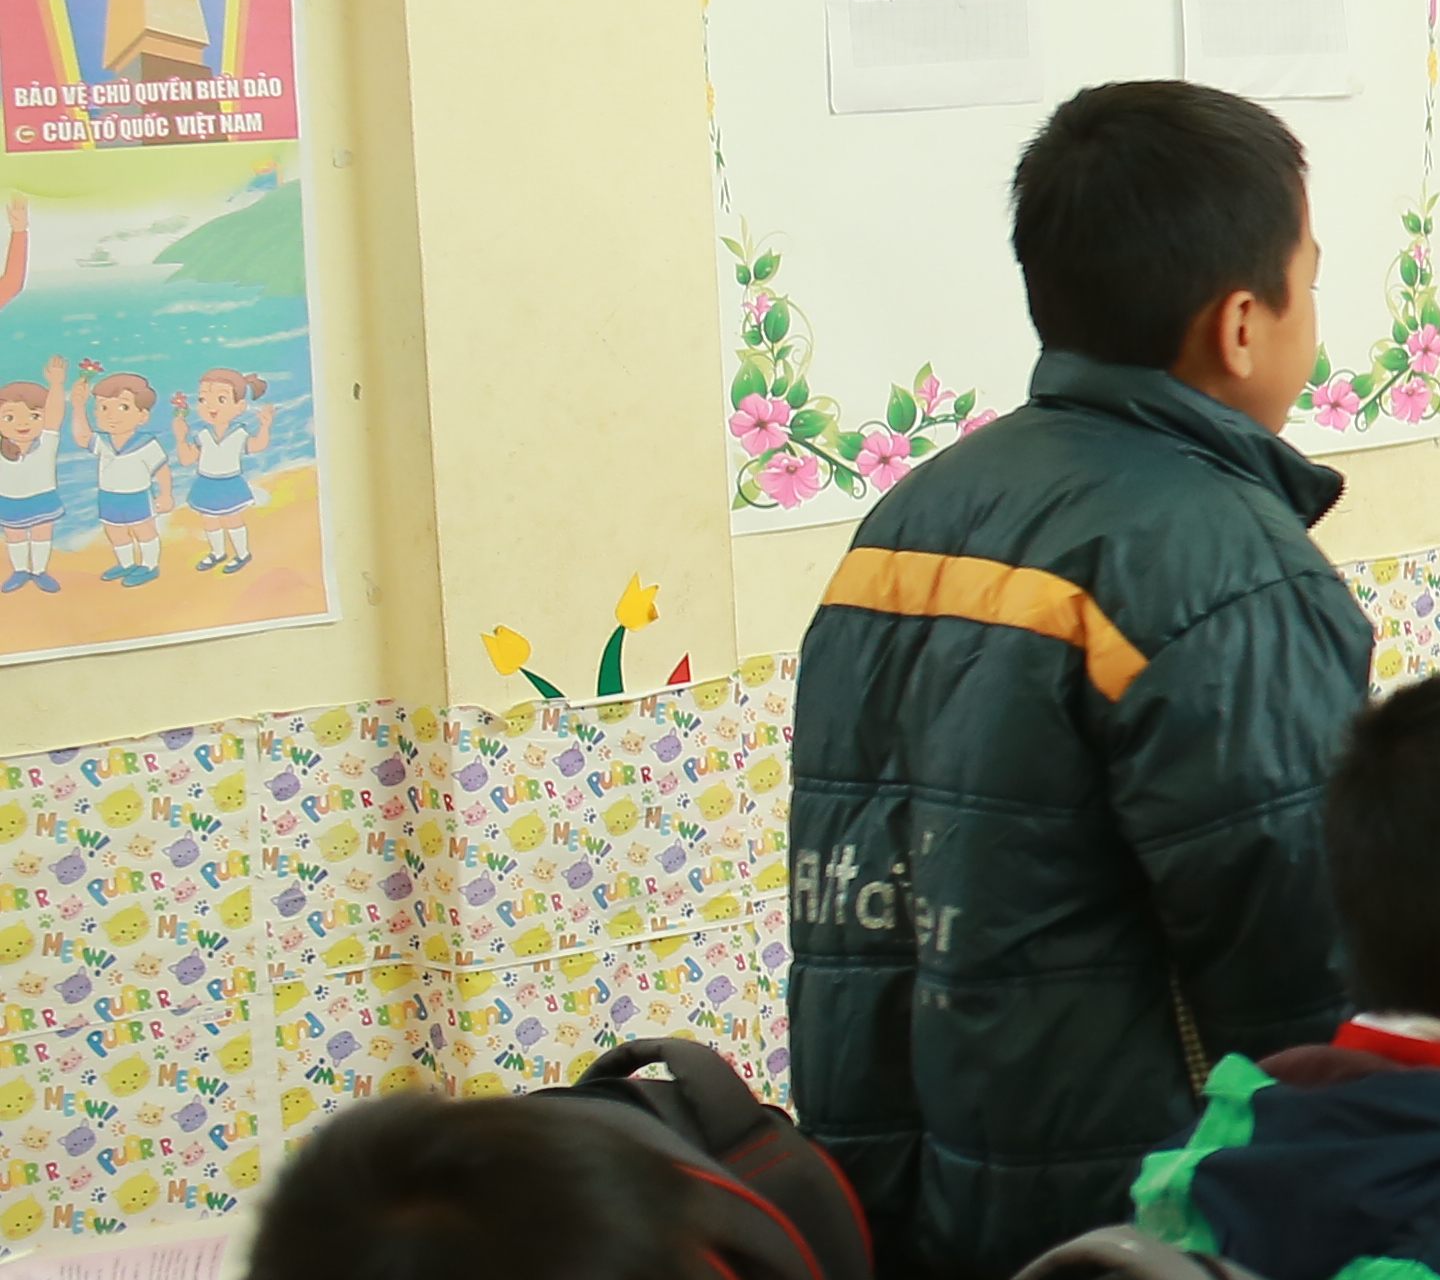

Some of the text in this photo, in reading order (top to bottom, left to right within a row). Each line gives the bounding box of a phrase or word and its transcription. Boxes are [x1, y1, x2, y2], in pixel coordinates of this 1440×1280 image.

[14, 80, 58, 108] BẢO
[62, 82, 88, 110] VỆ
[176, 111, 216, 139] VIỆT
[220, 112, 264, 133] NAM
[542, 708, 605, 752] MEOW!
[640, 695, 701, 738] MEOW!
[260, 730, 322, 776] MEOW!
[361, 717, 419, 765] MEOW!
[443, 721, 508, 767] MEOW!
[36, 812, 111, 858] MEOW!
[152, 796, 222, 841] MEOW!
[645, 806, 707, 849] MEOW!
[367, 831, 425, 879] MEOW!
[450, 837, 518, 882] MEOW!
[553, 822, 612, 865] MEOW!
[262, 847, 328, 891] MEOW!
[42, 932, 117, 977] MEOW!
[158, 914, 229, 959] MEOW!
[688, 1001, 747, 1041] MEOW!
[158, 1063, 229, 1105] MEOW!
[305, 1057, 373, 1098] MEOW!
[495, 1043, 561, 1085] MEOW!
[44, 1086, 118, 1128] MEOW!
